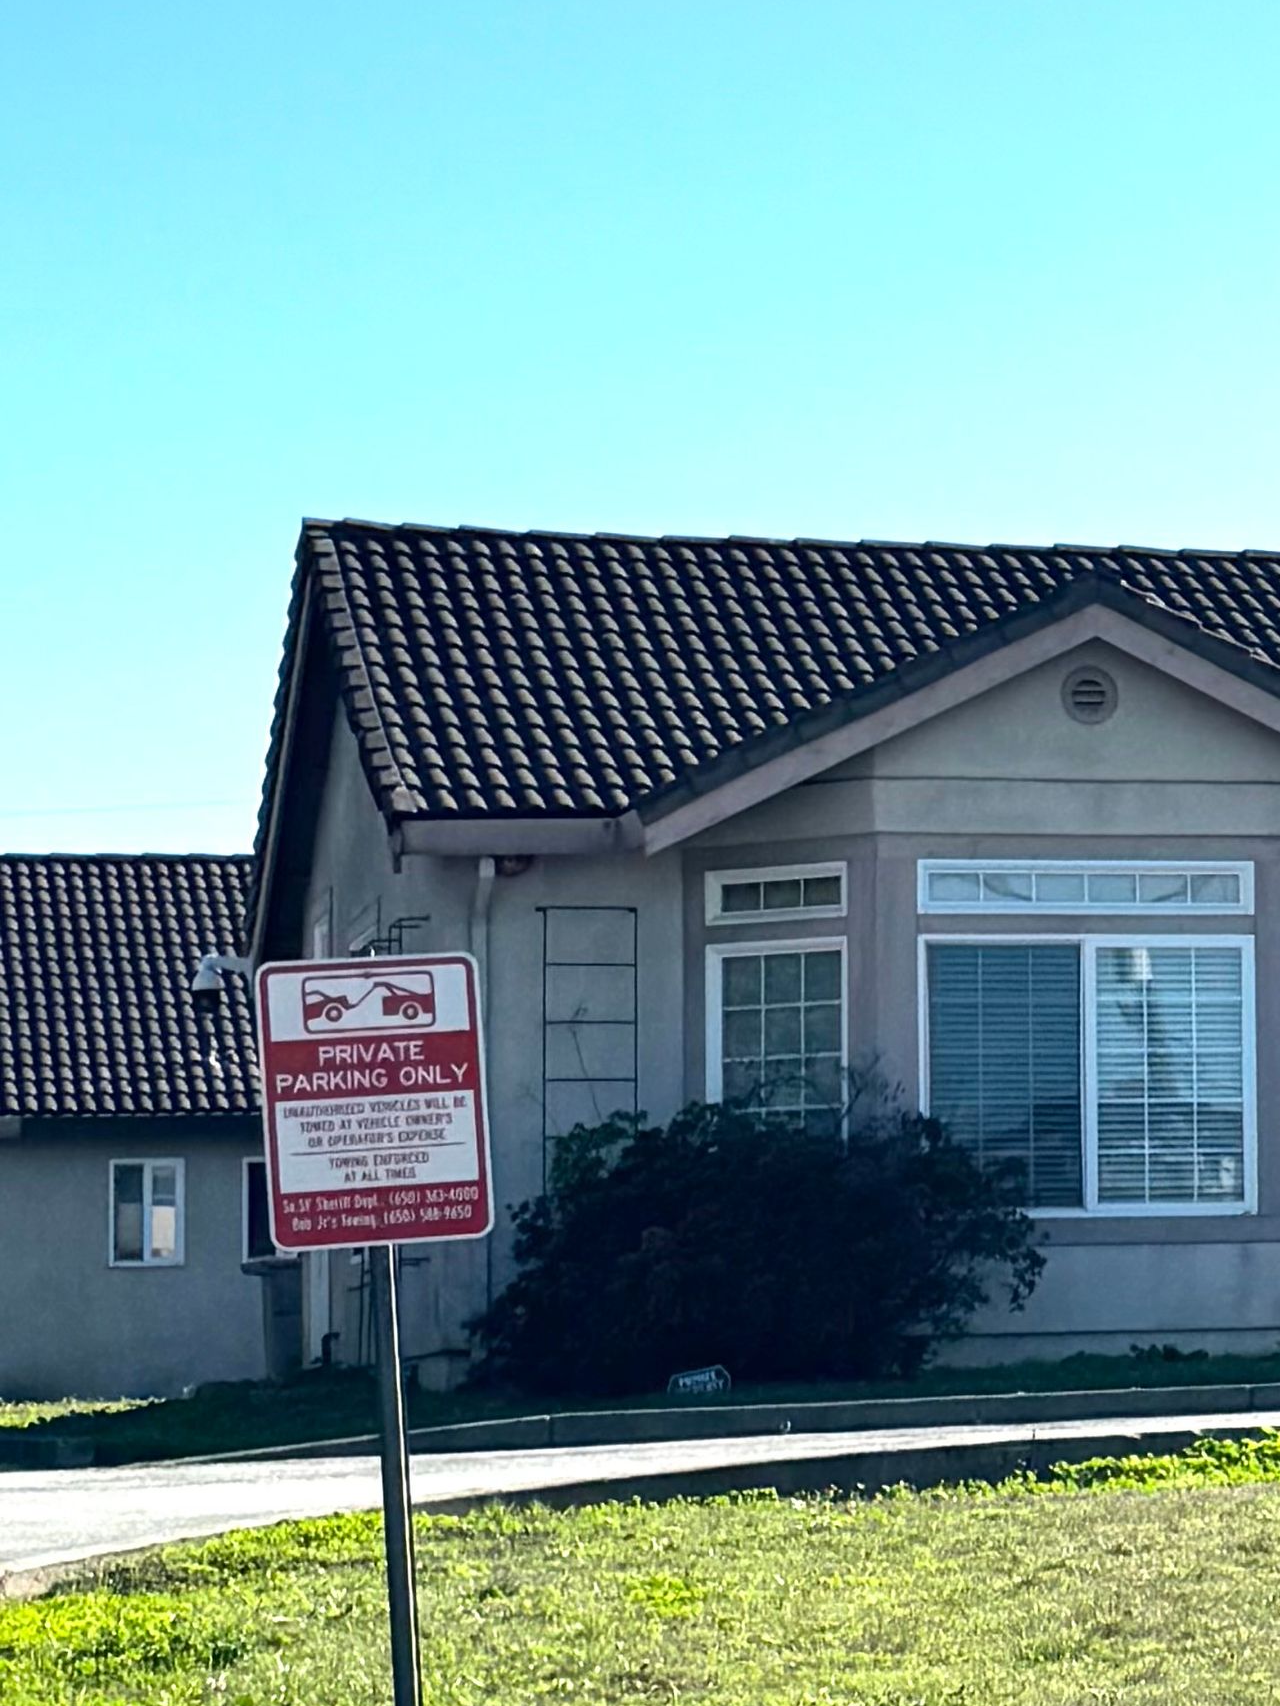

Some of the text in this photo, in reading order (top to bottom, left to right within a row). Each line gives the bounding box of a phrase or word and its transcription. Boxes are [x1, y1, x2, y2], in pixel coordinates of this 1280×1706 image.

[318, 1040, 425, 1067] PRIVATE
[275, 1062, 469, 1094] PARKING ONLY
[369, 1098, 421, 1113] VEHICLES
[424, 1096, 450, 1110] WILL
[453, 1095, 467, 1108] BE
[300, 1112, 453, 1134] TOWED AT VEHICLE OWNER'S
[308, 1128, 448, 1148] OR OPERATOR'S EXPENSE
[329, 1151, 429, 1170] TOWING ENFORCED
[344, 1166, 417, 1183] AT ALL TIMES
[315, 1194, 351, 1211] Sheriff
[389, 1190, 421, 1206] (650)
[384, 1210, 416, 1226] (650)
